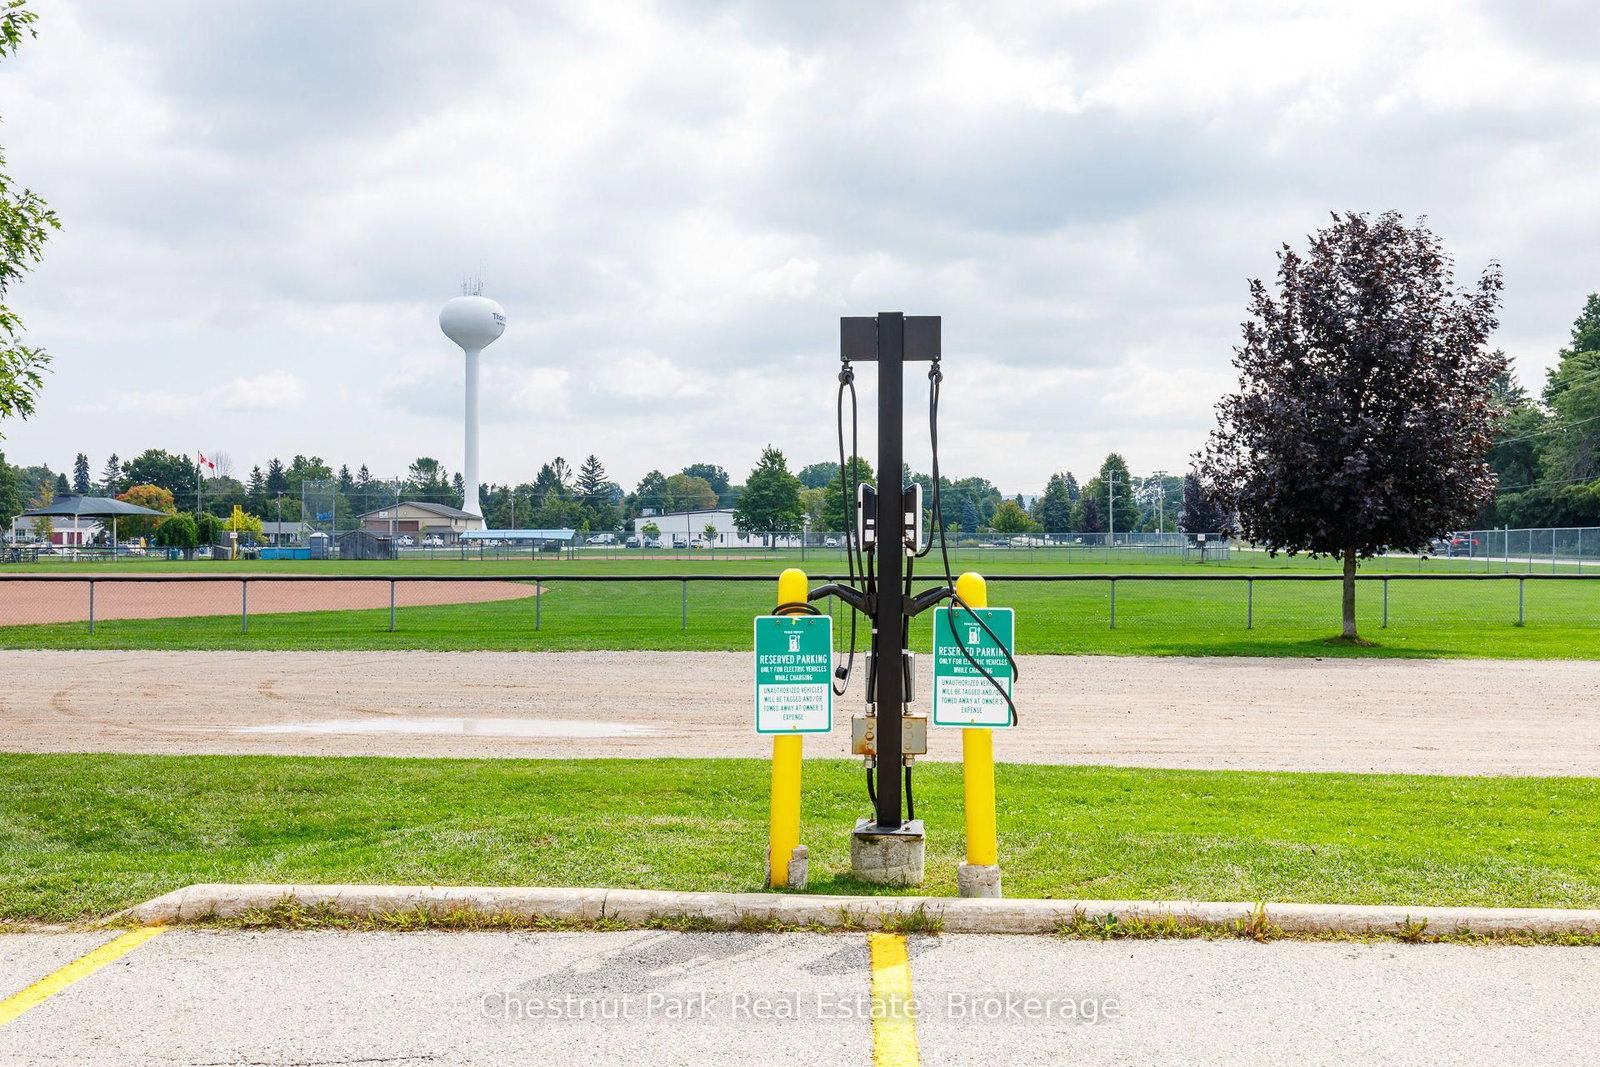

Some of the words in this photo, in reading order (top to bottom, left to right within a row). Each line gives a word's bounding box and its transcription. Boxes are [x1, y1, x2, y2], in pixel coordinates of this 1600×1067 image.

[938, 646, 974, 656] RESERED
[760, 654, 794, 664] RESERVED
[796, 654, 828, 664] PARKING
